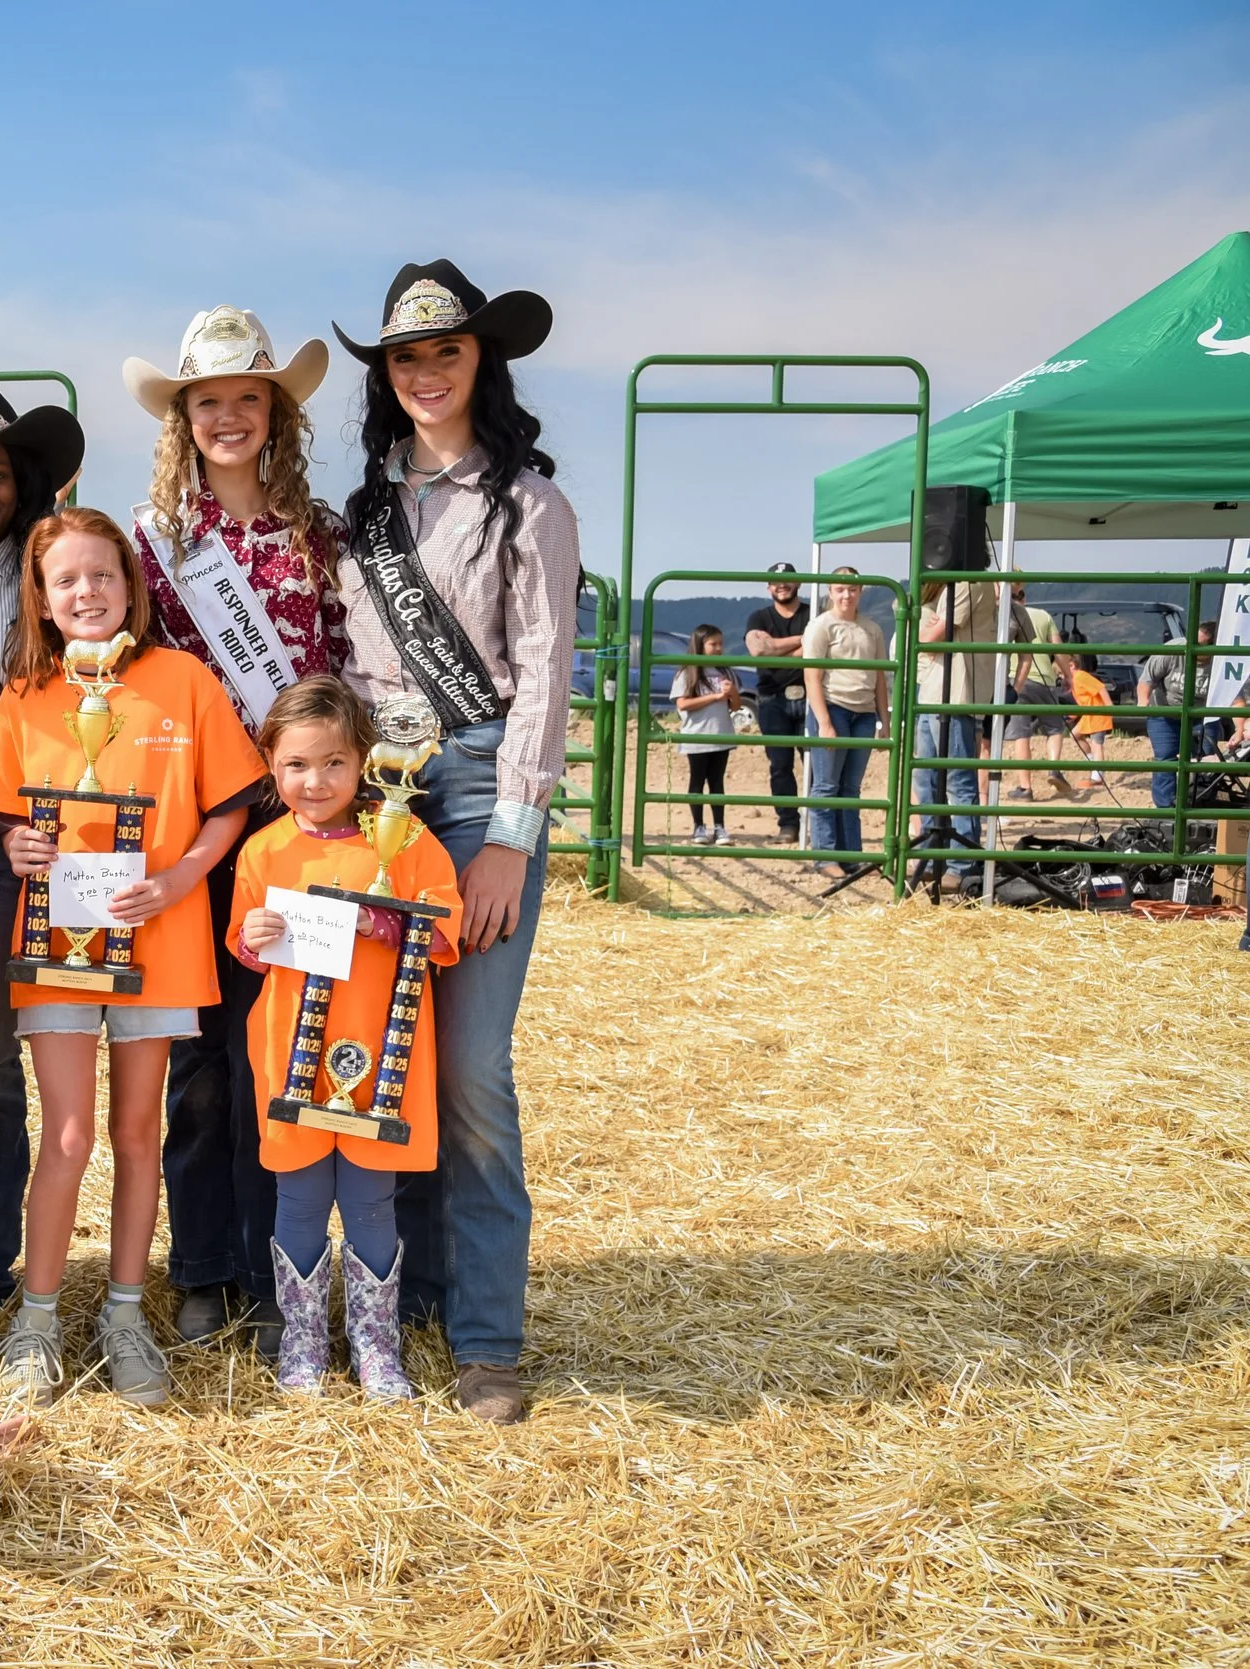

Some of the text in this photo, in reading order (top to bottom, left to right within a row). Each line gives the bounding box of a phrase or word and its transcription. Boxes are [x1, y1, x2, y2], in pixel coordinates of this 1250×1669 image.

[181, 560, 224, 586] Princess
[213, 577, 269, 657] RESPONDER
[218, 628, 255, 675] RODEO
[405, 639, 440, 680] Queen
[427, 636, 496, 717] Fair & Rodeo
[134, 736, 194, 746] STERLING RANC
[116, 825, 142, 840] 2025
[63, 867, 135, 882] Mutton Bustin'
[281, 910, 312, 924] Mutton
[309, 935, 331, 949] Place
[406, 929, 431, 945] 2025
[401, 953, 428, 970] 2025
[305, 986, 330, 1003] 2025
[396, 979, 422, 996] 2025
[301, 1011, 326, 1028] 2025
[391, 1004, 418, 1021] 2025
[296, 1036, 322, 1053] 2025
[386, 1029, 413, 1047] 2025
[291, 1061, 317, 1078] 2025
[381, 1054, 408, 1071] 2025
[377, 1079, 404, 1097] 2025
